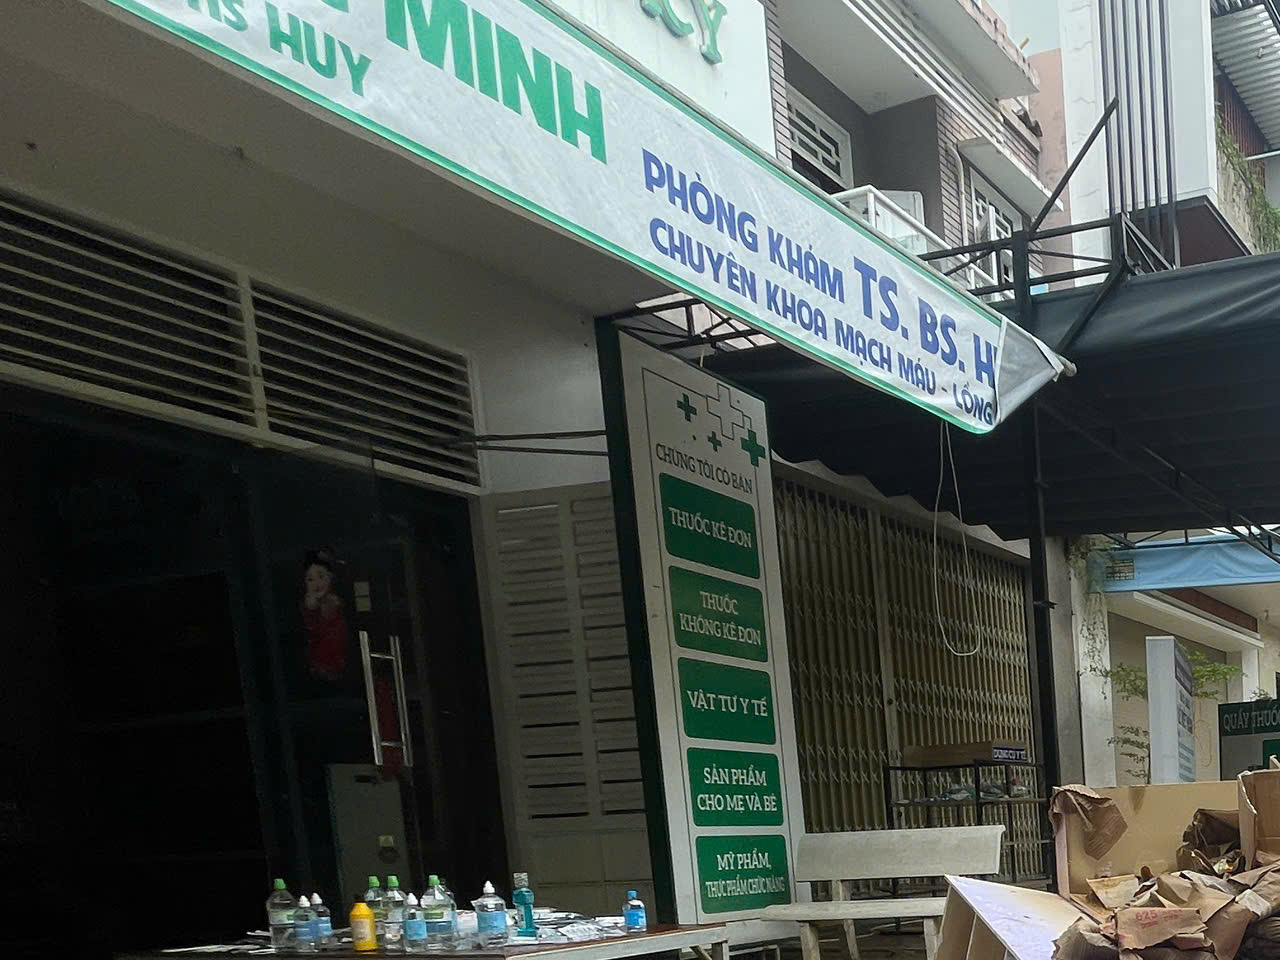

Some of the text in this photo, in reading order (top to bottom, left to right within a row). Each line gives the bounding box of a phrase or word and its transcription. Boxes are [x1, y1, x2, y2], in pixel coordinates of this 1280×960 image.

[265, 1, 372, 97] HUY
[384, 0, 607, 165] MINH
[642, 148, 998, 390] PHÒNG KHÁM TS. BS. H
[649, 217, 758, 304] CHUYÊN
[765, 279, 828, 341] KHOA
[834, 317, 892, 373] MẠCH
[898, 351, 936, 396] MÁU
[668, 506, 711, 536] THUỐC
[699, 590, 739, 615] THUỐC
[680, 613, 761, 646] KHÔNG KÊ ĐƠN
[686, 688, 768, 717] VẬT TƯ Y TẾ
[703, 763, 767, 787] SẢN PHẨM
[697, 793, 724, 811] CHO
[725, 794, 745, 814] MẸ
[745, 791, 763, 812] VÀ
[716, 847, 772, 871] MỸ PHẨM,
